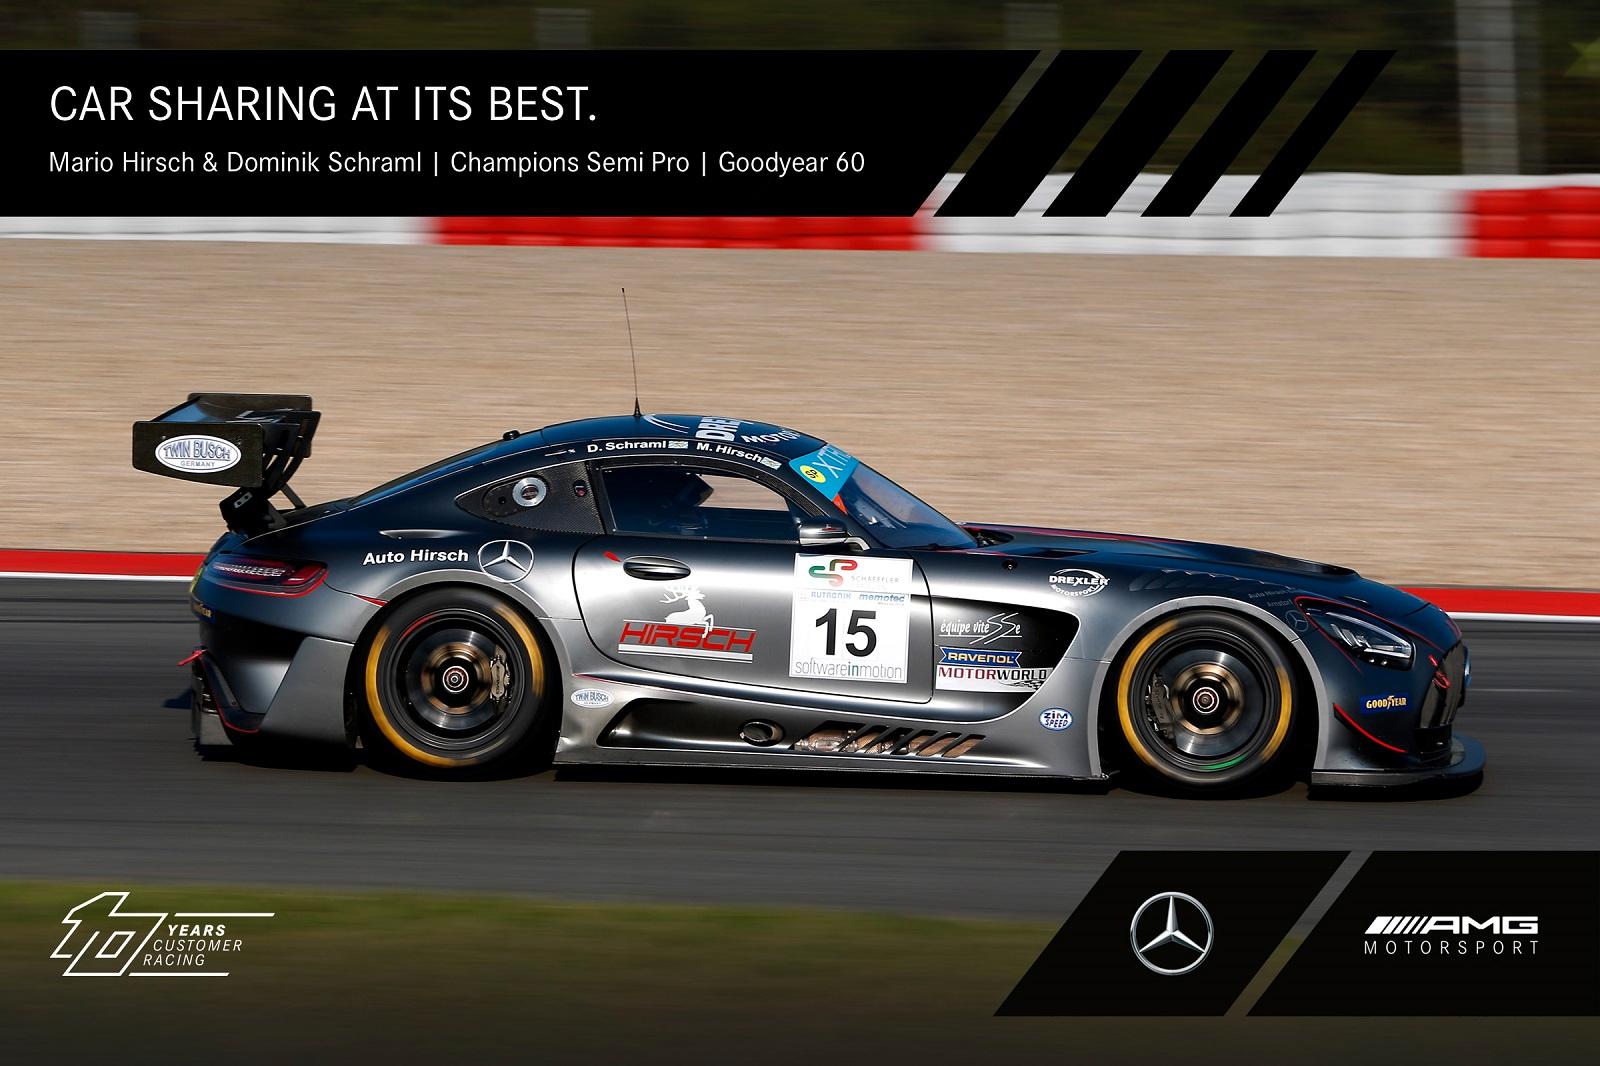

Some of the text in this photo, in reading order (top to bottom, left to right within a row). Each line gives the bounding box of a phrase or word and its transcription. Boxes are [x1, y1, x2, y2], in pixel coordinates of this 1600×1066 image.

[163, 440, 231, 459] TWIN BUSCH
[587, 441, 667, 453] D. Schraml
[696, 442, 763, 464] M. Hirsch
[180, 460, 215, 468] GERMANY
[362, 550, 469, 565] Auto Hirsch
[1049, 575, 1110, 586] DREXLER
[858, 593, 905, 603] memotec
[619, 623, 757, 653] HIRSCH
[815, 608, 877, 657] 15
[1366, 696, 1406, 709] GOODYEAR
[1045, 719, 1068, 728] SPEED
